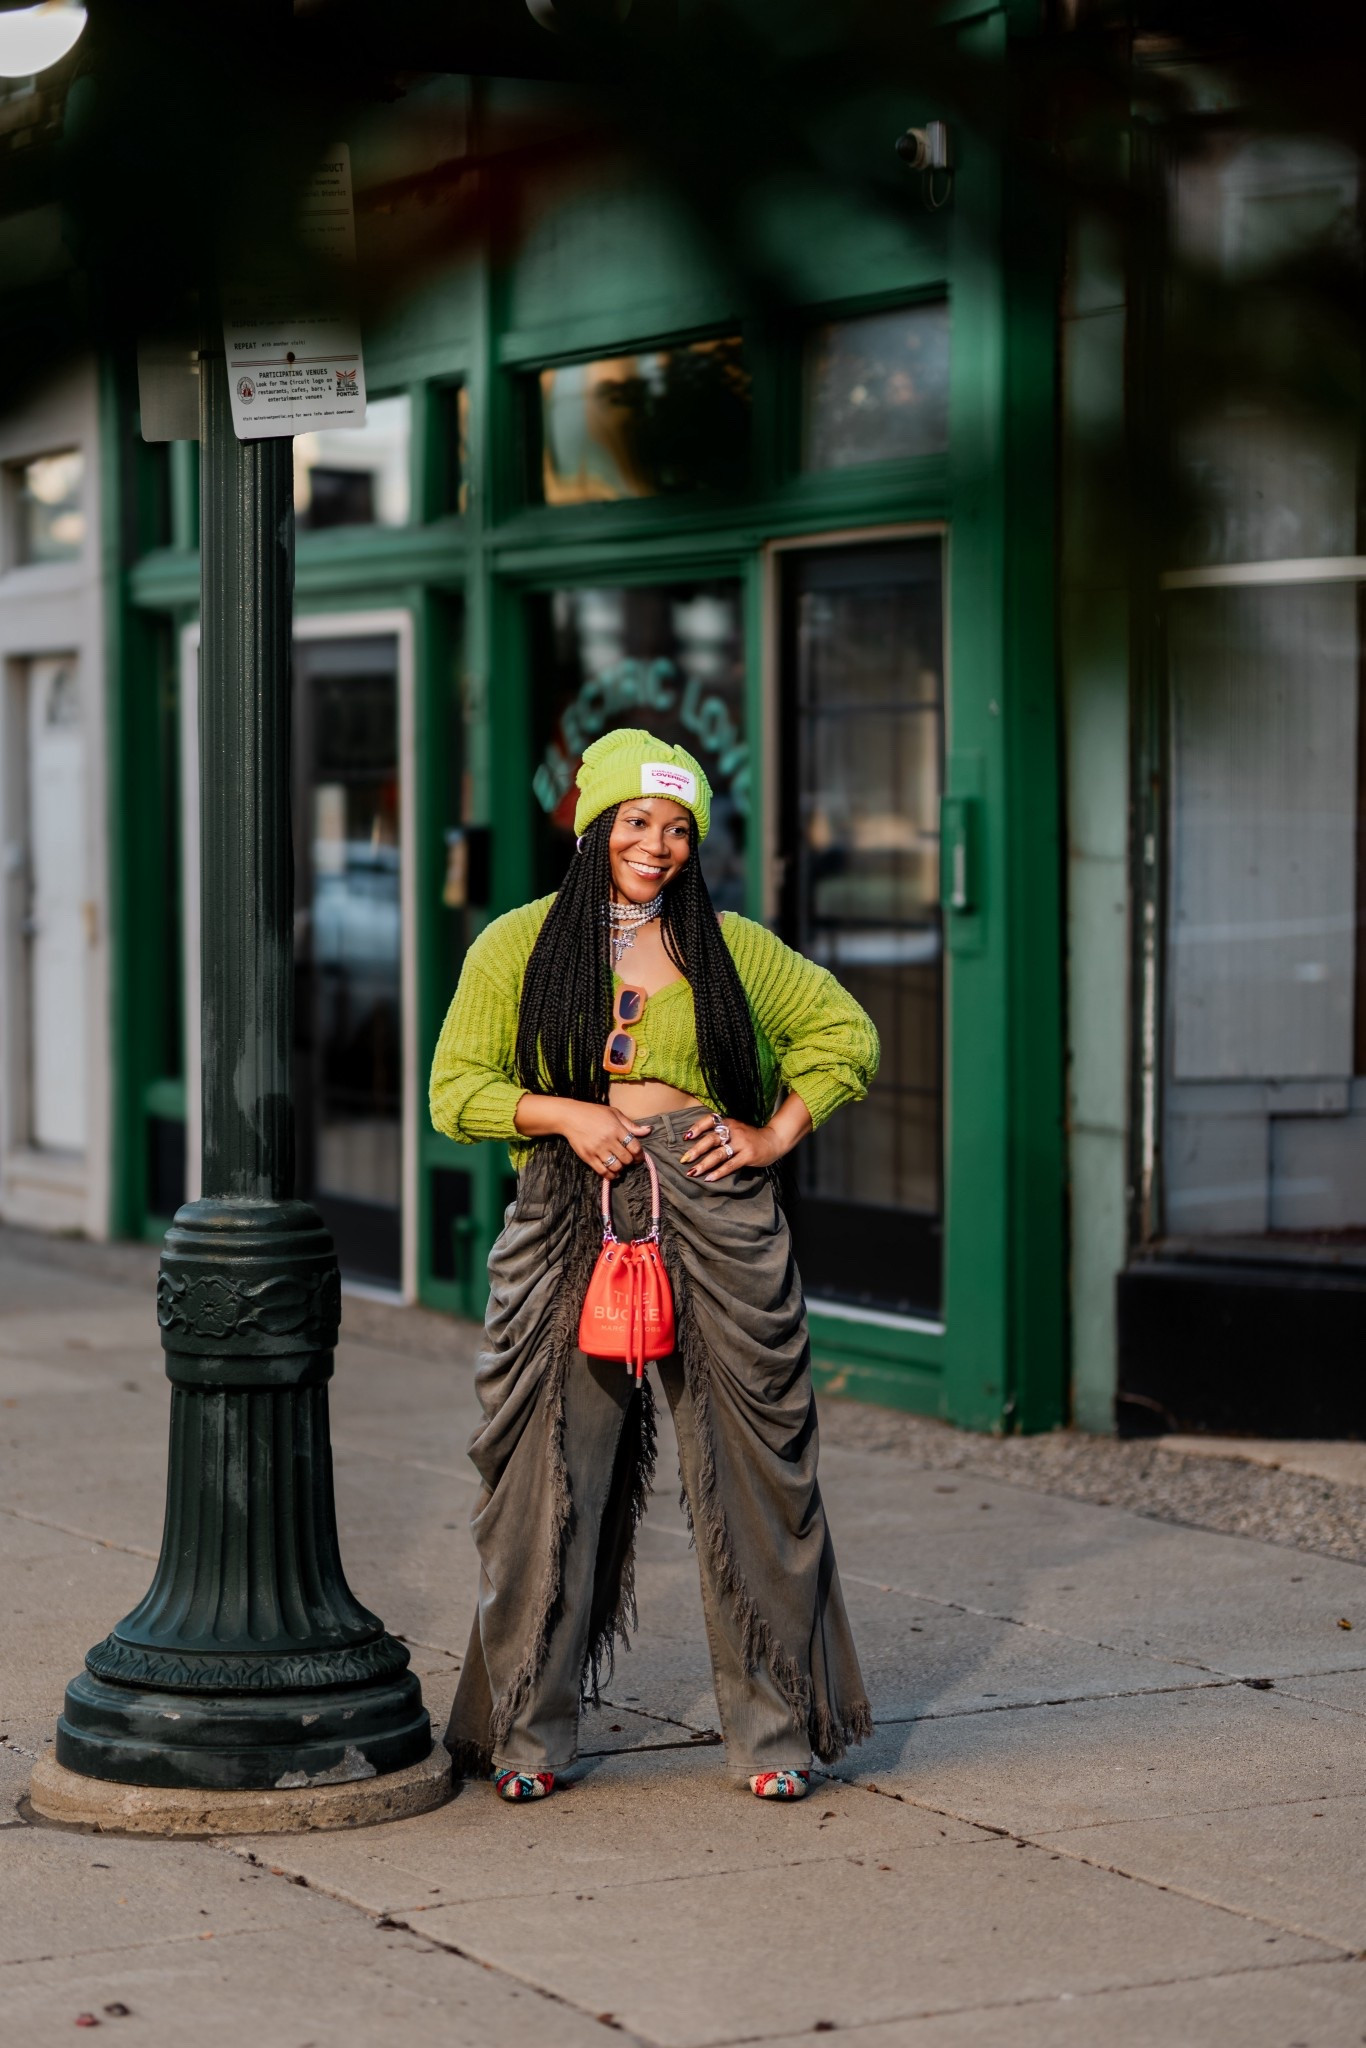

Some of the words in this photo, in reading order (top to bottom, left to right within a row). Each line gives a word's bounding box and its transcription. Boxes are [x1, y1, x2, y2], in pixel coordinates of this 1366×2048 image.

[234, 342, 257, 350] REPEAT
[259, 370, 303, 379] PARTICIPATING
[305, 368, 328, 376] VENUES
[289, 378, 310, 386] Circuit
[652, 773, 690, 784] LOVERBOY
